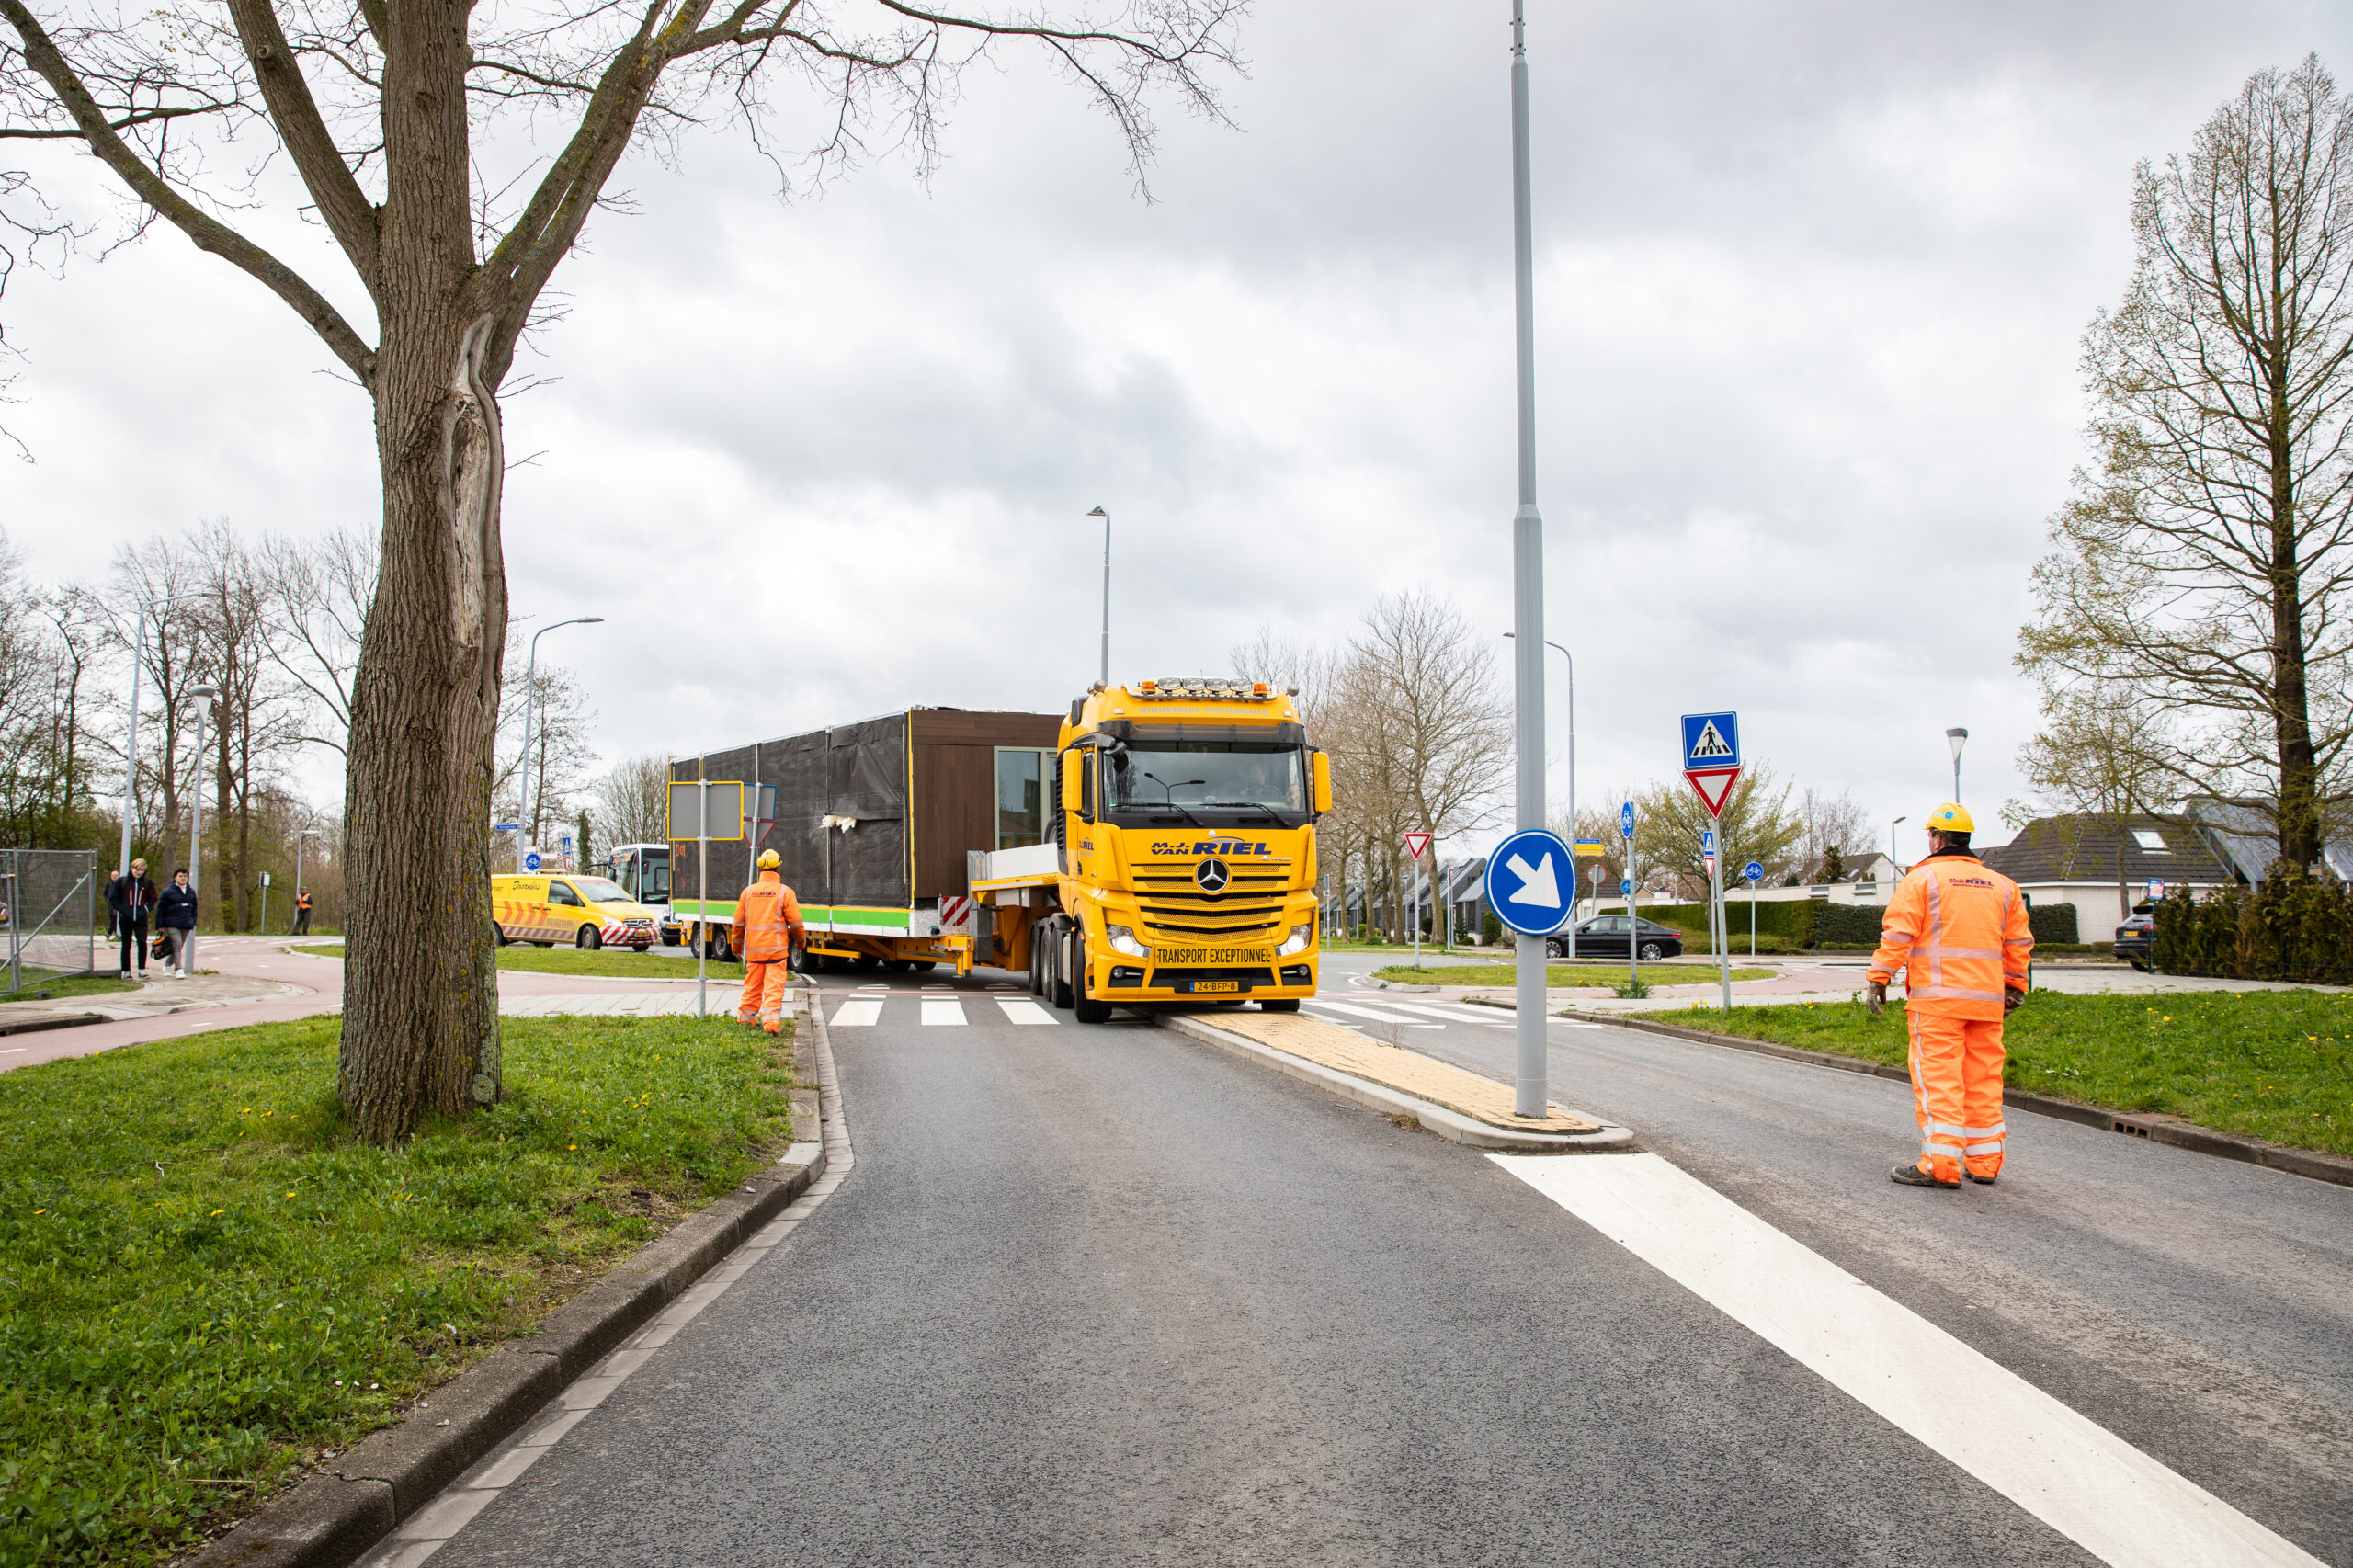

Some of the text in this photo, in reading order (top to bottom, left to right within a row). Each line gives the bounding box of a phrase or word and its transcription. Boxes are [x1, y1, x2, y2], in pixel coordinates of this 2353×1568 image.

[1139, 706, 1268, 716] INDUSTRIAL MOVEMENTS
[1192, 842, 1272, 855] RIEL
[1157, 948, 1271, 963] TRANSPORT EXCEPTIONNEL
[1198, 983, 1236, 991] 24-BFP-8
